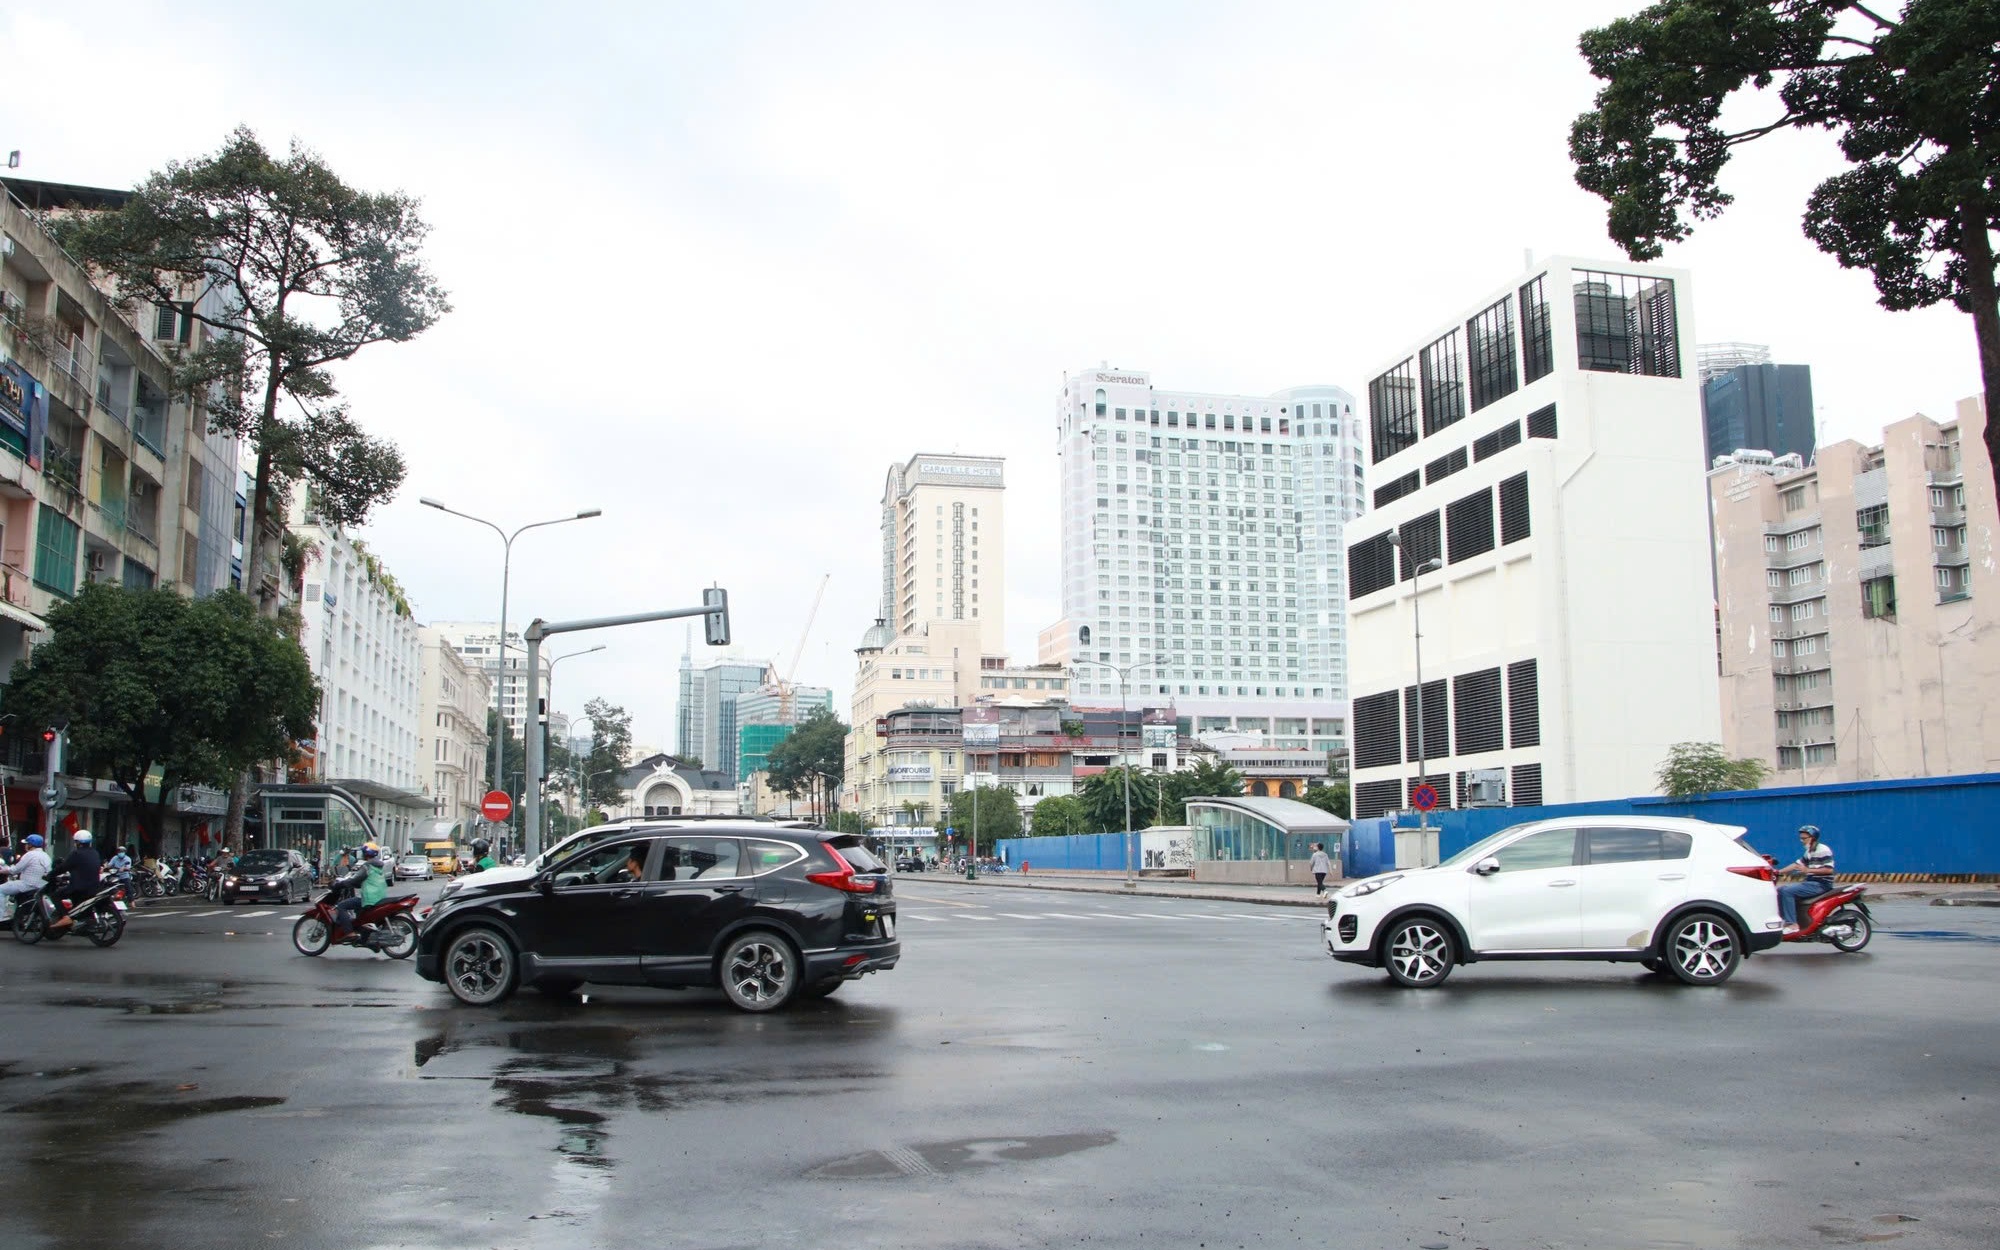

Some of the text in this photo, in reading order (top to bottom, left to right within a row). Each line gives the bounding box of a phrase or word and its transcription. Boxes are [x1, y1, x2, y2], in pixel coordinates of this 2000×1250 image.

[1095, 372, 1145, 385] Sheraton
[923, 464, 1000, 476] CARAVELLE HOTEL
